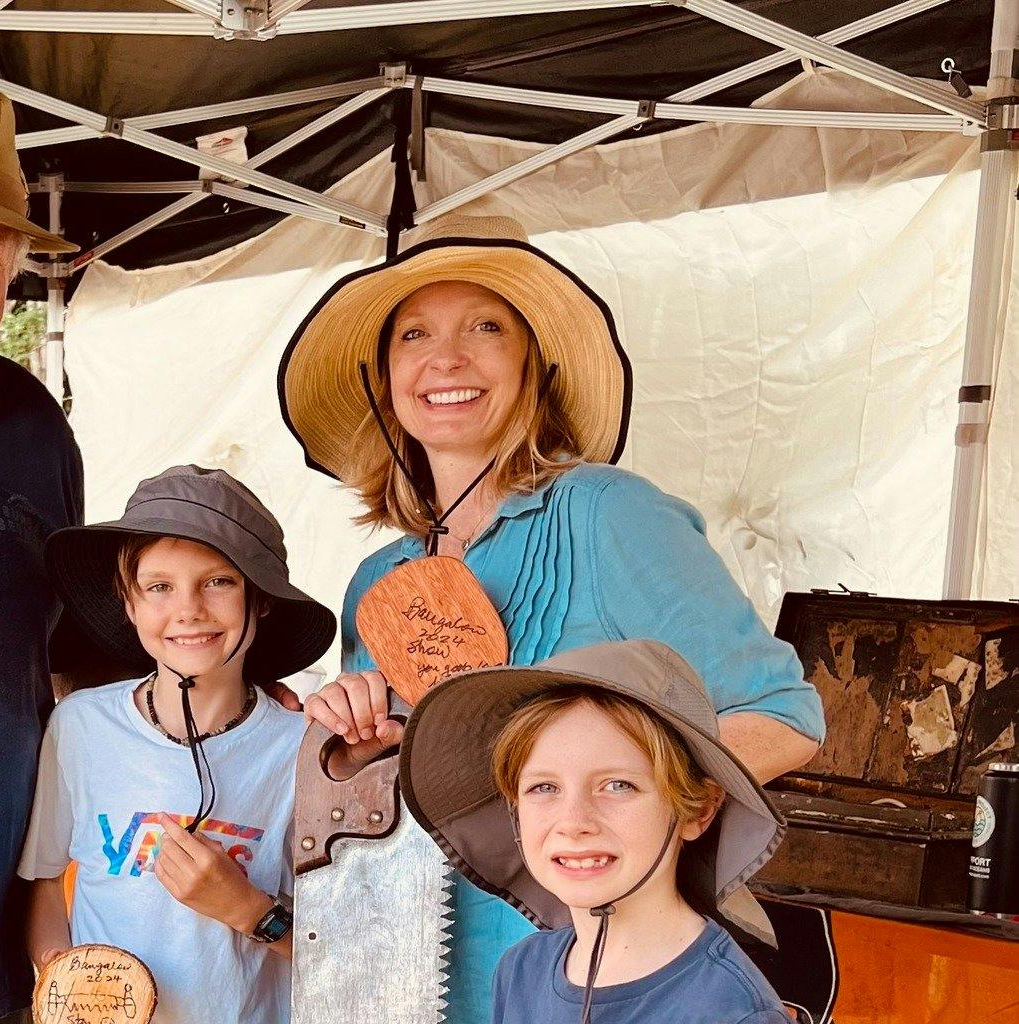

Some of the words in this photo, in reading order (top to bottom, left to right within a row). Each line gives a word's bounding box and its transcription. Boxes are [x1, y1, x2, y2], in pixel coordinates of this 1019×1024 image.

[418, 628, 466, 648] 2024
[407, 640, 450, 659] Show
[86, 974, 123, 983] 2024
